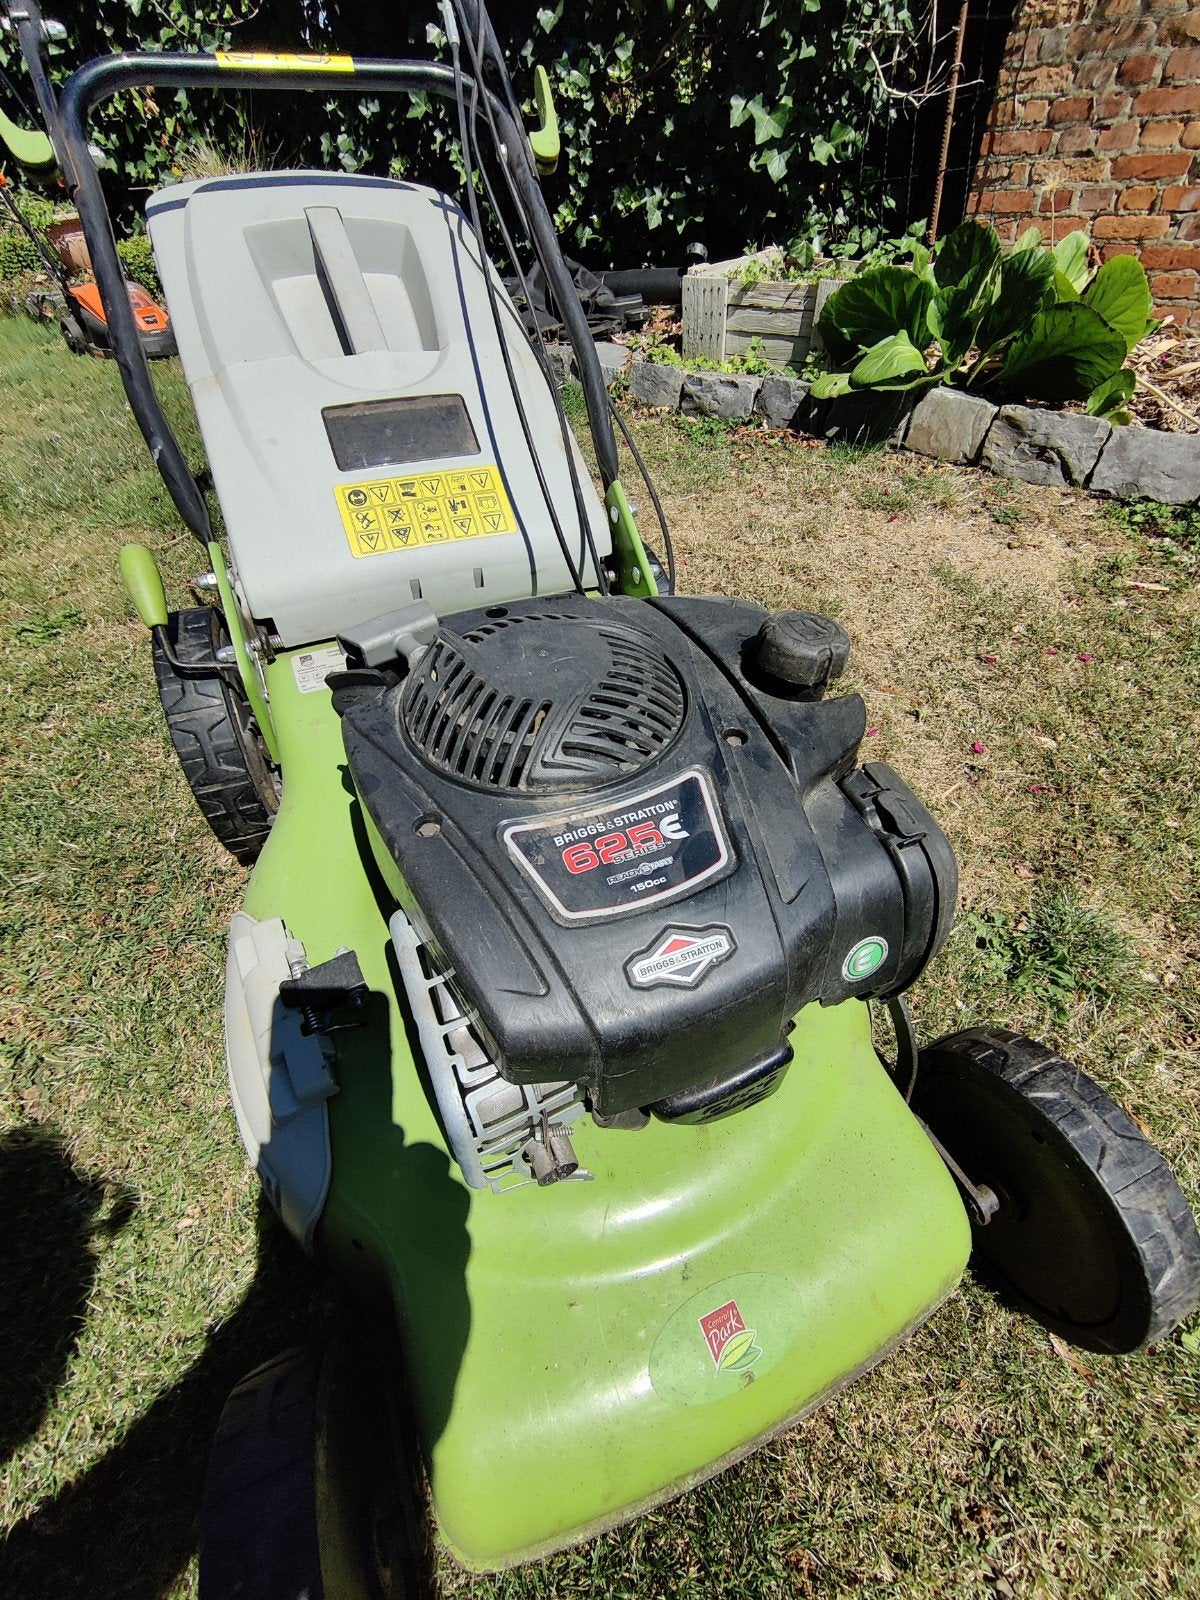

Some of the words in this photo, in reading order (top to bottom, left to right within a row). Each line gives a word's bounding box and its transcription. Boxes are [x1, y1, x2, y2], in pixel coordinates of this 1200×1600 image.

[553, 822, 607, 847] BRIGGS
[613, 841, 666, 865] SERIES
[630, 876, 667, 893] 150cc
[639, 956, 676, 976] BRIGGS
[681, 941, 723, 960] STRATTON
[708, 1311, 731, 1328] Central
[708, 1309, 743, 1354] Park
